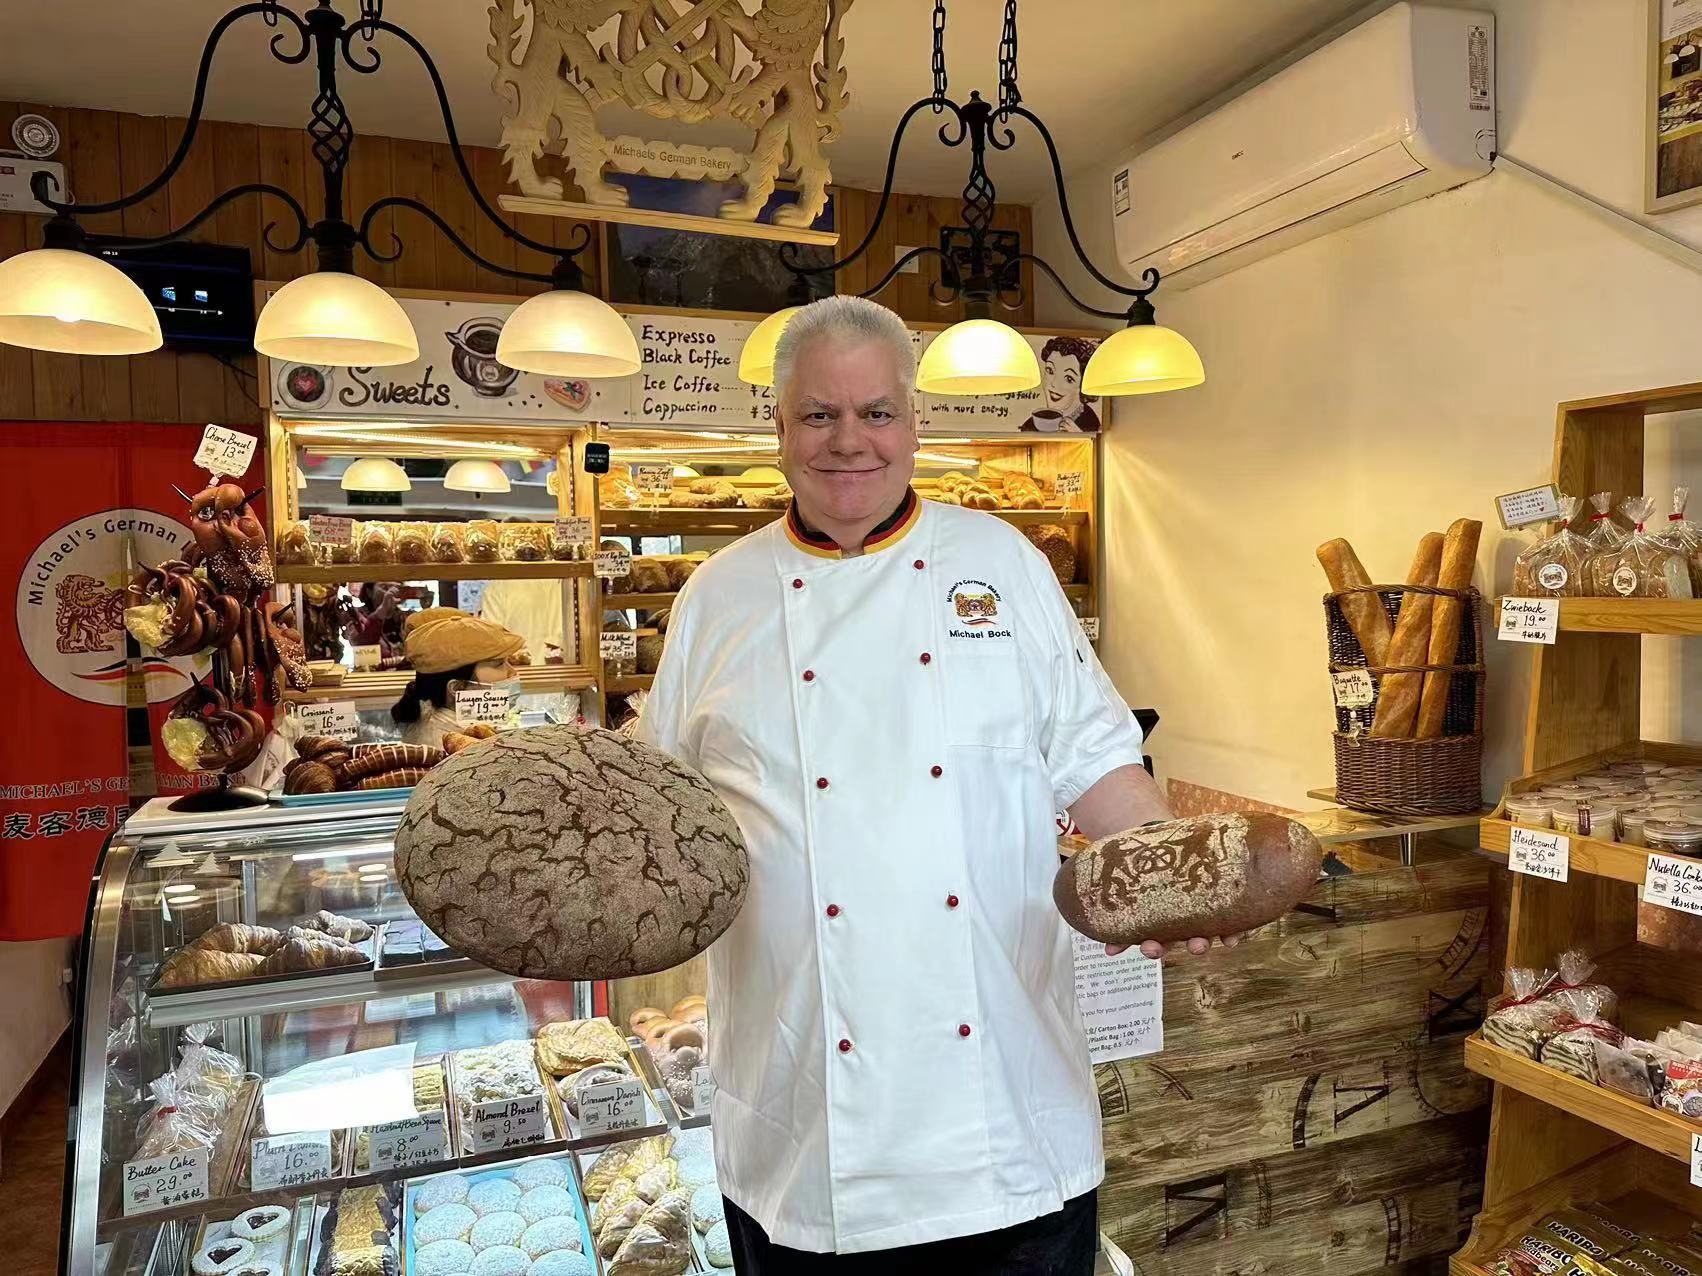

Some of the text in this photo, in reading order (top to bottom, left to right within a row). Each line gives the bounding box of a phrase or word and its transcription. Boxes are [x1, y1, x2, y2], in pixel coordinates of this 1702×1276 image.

[613, 144, 656, 159] Michaels
[700, 157, 732, 170] Bakery
[641, 325, 716, 347] Expresso
[641, 348, 732, 369] Black Coffee
[338, 365, 451, 408] Sweets
[643, 374, 666, 390] Ice
[674, 375, 720, 393] Coffee
[642, 397, 717, 421] Cappuccino
[931, 403, 950, 413] with
[953, 405, 975, 414] more
[28, 519, 177, 606] Michael's German
[962, 579, 987, 587] German
[1502, 600, 1547, 614] Zwieback
[949, 629, 1012, 639] Michael Bock
[301, 706, 334, 718] Croissant
[0, 777, 102, 800] MICHAEL'S
[1512, 829, 1559, 851] Heidesand
[1097, 960, 1119, 969] respond
[1087, 970, 1114, 979] restriction
[1123, 975, 1142, 983] provide
[1086, 991, 1099, 999] bags
[1107, 985, 1132, 995] additional
[1132, 982, 1158, 991] packaging
[1085, 1010, 1096, 1018] you
[1097, 1025, 1117, 1033] Carton
[1129, 1020, 1140, 1028] 2.00
[475, 1103, 509, 1123] Almond
[127, 1155, 197, 1181] Butter Cake
[1547, 1221, 1603, 1257] HARIBO
